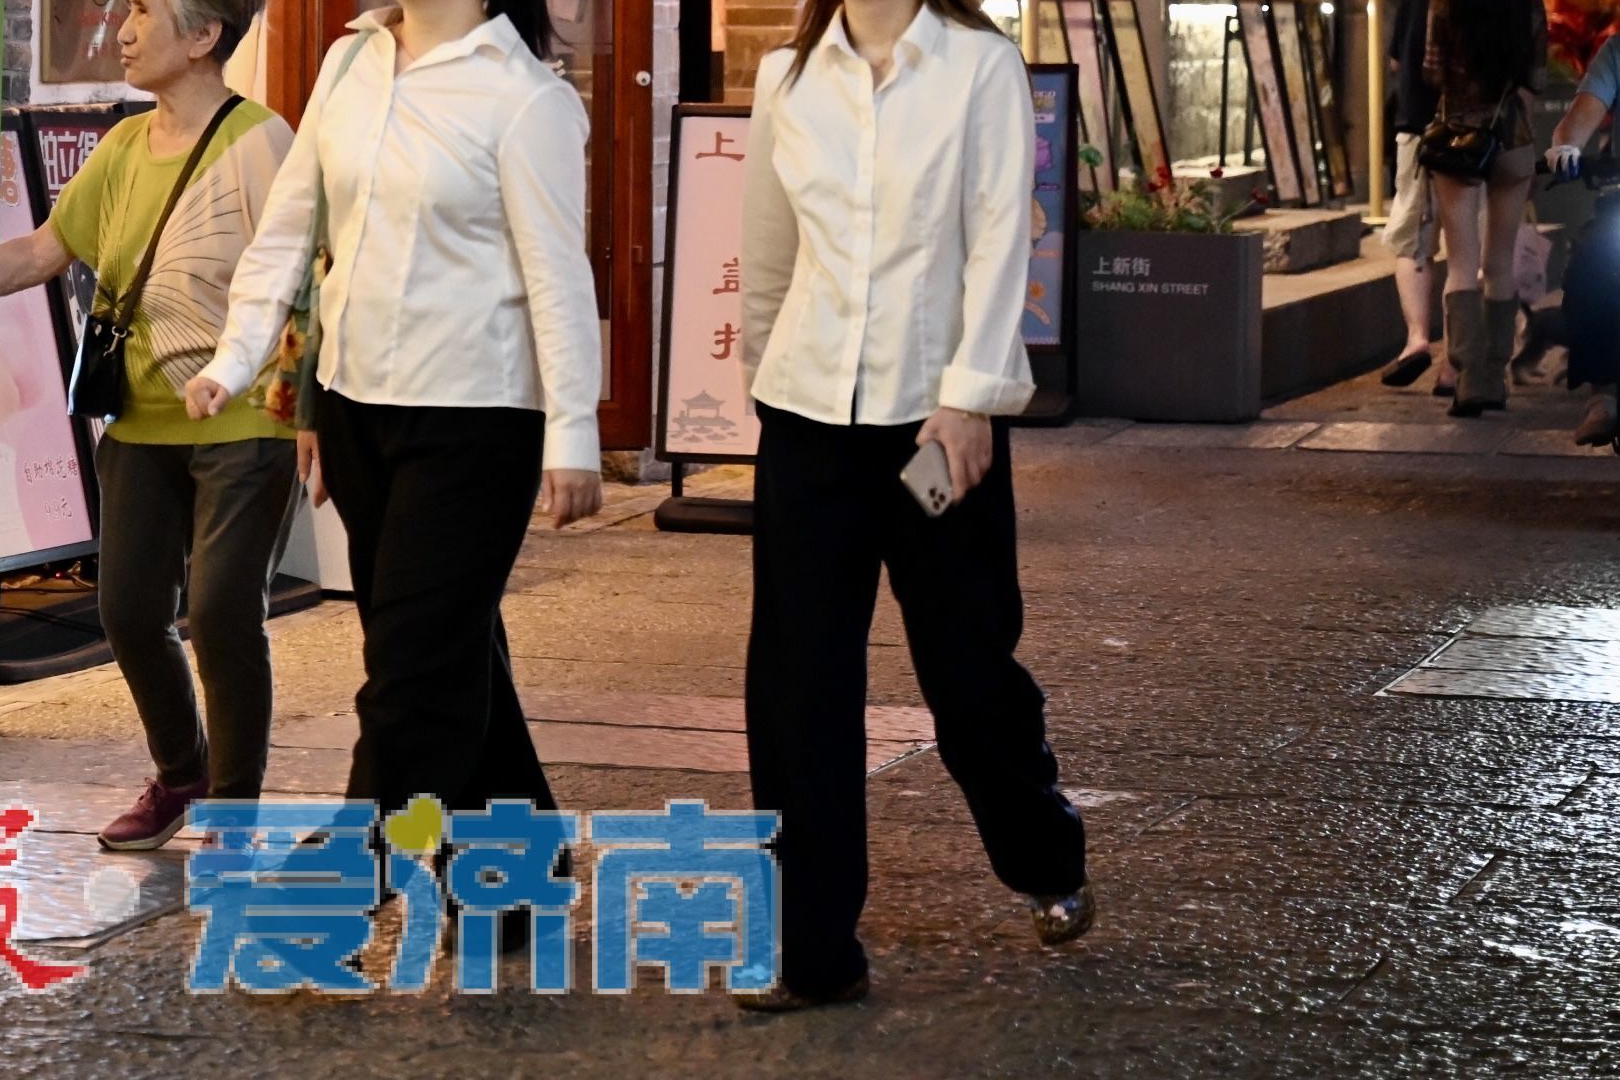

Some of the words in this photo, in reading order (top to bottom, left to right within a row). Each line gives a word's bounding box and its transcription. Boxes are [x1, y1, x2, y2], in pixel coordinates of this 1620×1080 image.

[1092, 256, 1151, 277] 上新街
[1092, 280, 1136, 293] SHANG
[1138, 282, 1159, 294] XIN
[1161, 282, 1209, 295] STREET
